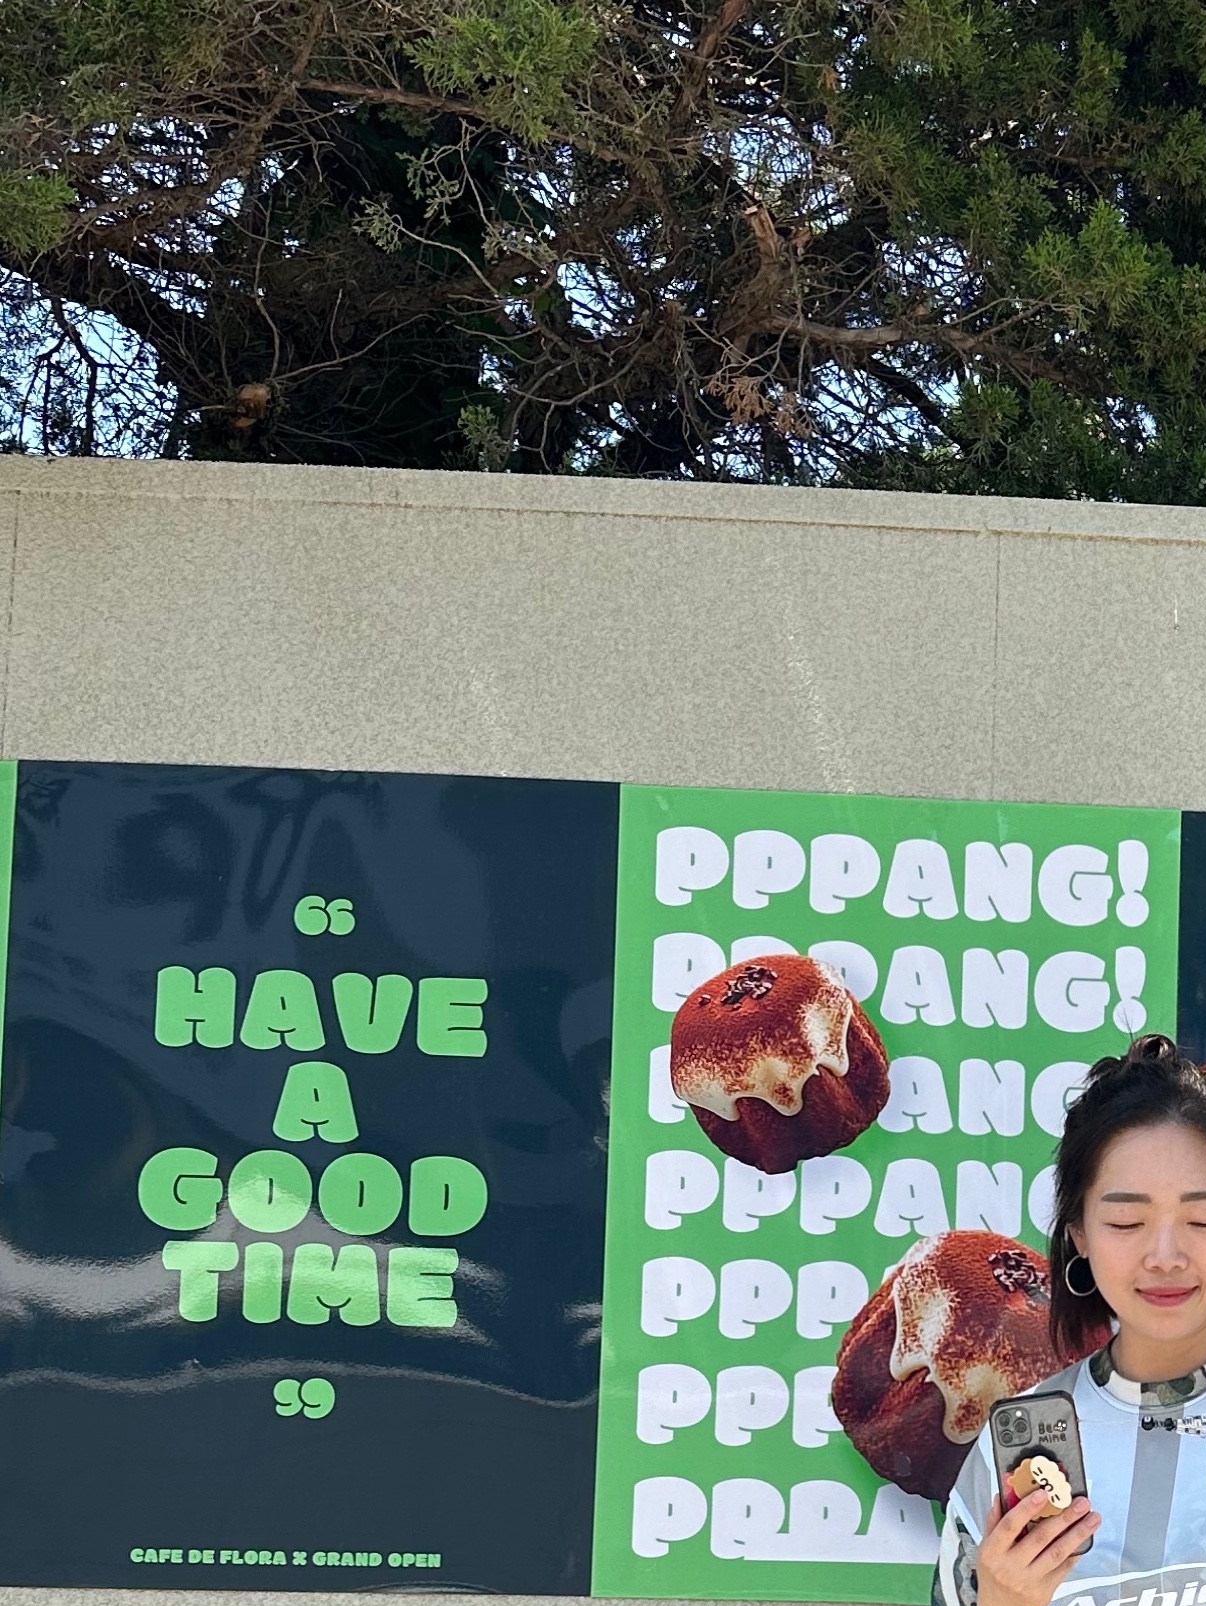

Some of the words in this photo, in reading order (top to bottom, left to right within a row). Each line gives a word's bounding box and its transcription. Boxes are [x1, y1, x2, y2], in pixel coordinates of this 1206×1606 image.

[655, 826, 1149, 928] PPPANG!
[154, 966, 488, 1057] HAVE
[652, 932, 1147, 1033] PANG!
[273, 1061, 359, 1144] A
[138, 1147, 488, 1237] GOOD
[162, 1241, 460, 1327] TIME
[130, 1548, 183, 1564] CAFE
[188, 1549, 215, 1564] DE
[220, 1550, 287, 1565] FLORA
[292, 1551, 307, 1565] X
[312, 1552, 383, 1566] GRAND
[388, 1553, 442, 1568] OPEN
